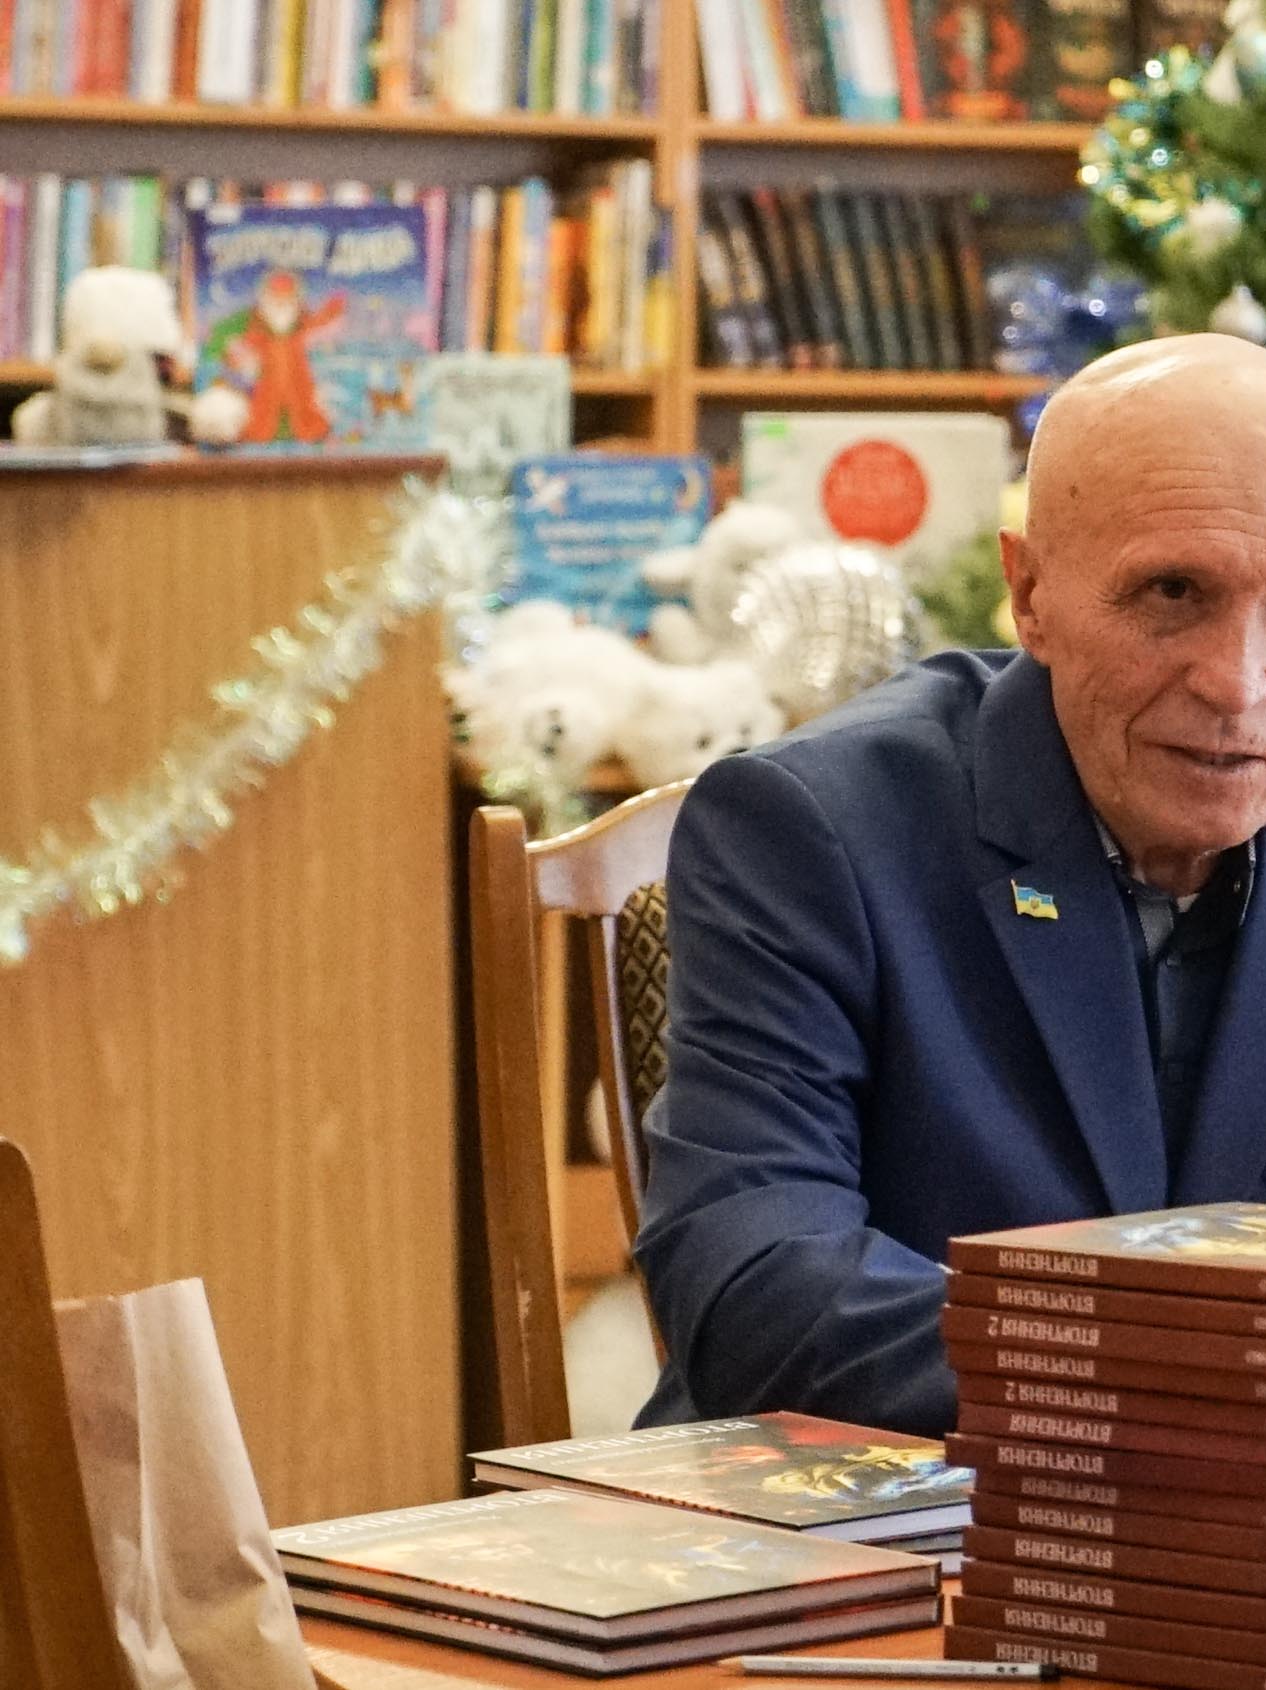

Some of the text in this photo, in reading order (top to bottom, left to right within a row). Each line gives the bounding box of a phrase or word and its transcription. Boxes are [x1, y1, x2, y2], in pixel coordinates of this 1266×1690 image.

[999, 1250, 1098, 1277] ВТОРГНЕННЯ
[997, 1286, 1095, 1314] ВТОРГНЕННЯ
[988, 1315, 1099, 1347] ВТОРГНЕННЯ 2
[997, 1350, 1095, 1377] ВТОРГНЕННЯ
[1005, 1381, 1118, 1412] ВТОРГНЕННЯ 2
[1009, 1413, 1112, 1443] ВТОРГНЕННЯ
[998, 1446, 1104, 1474] ВТОРГНЕННЯ
[1018, 1506, 1114, 1535] ВТОРГНЕННЯ
[1015, 1539, 1113, 1569] ВТОРГНЕННЯ
[1013, 1577, 1115, 1608] ВТОРГНЕННЯ
[1004, 1608, 1107, 1638] ВТОРГНЕННЯ
